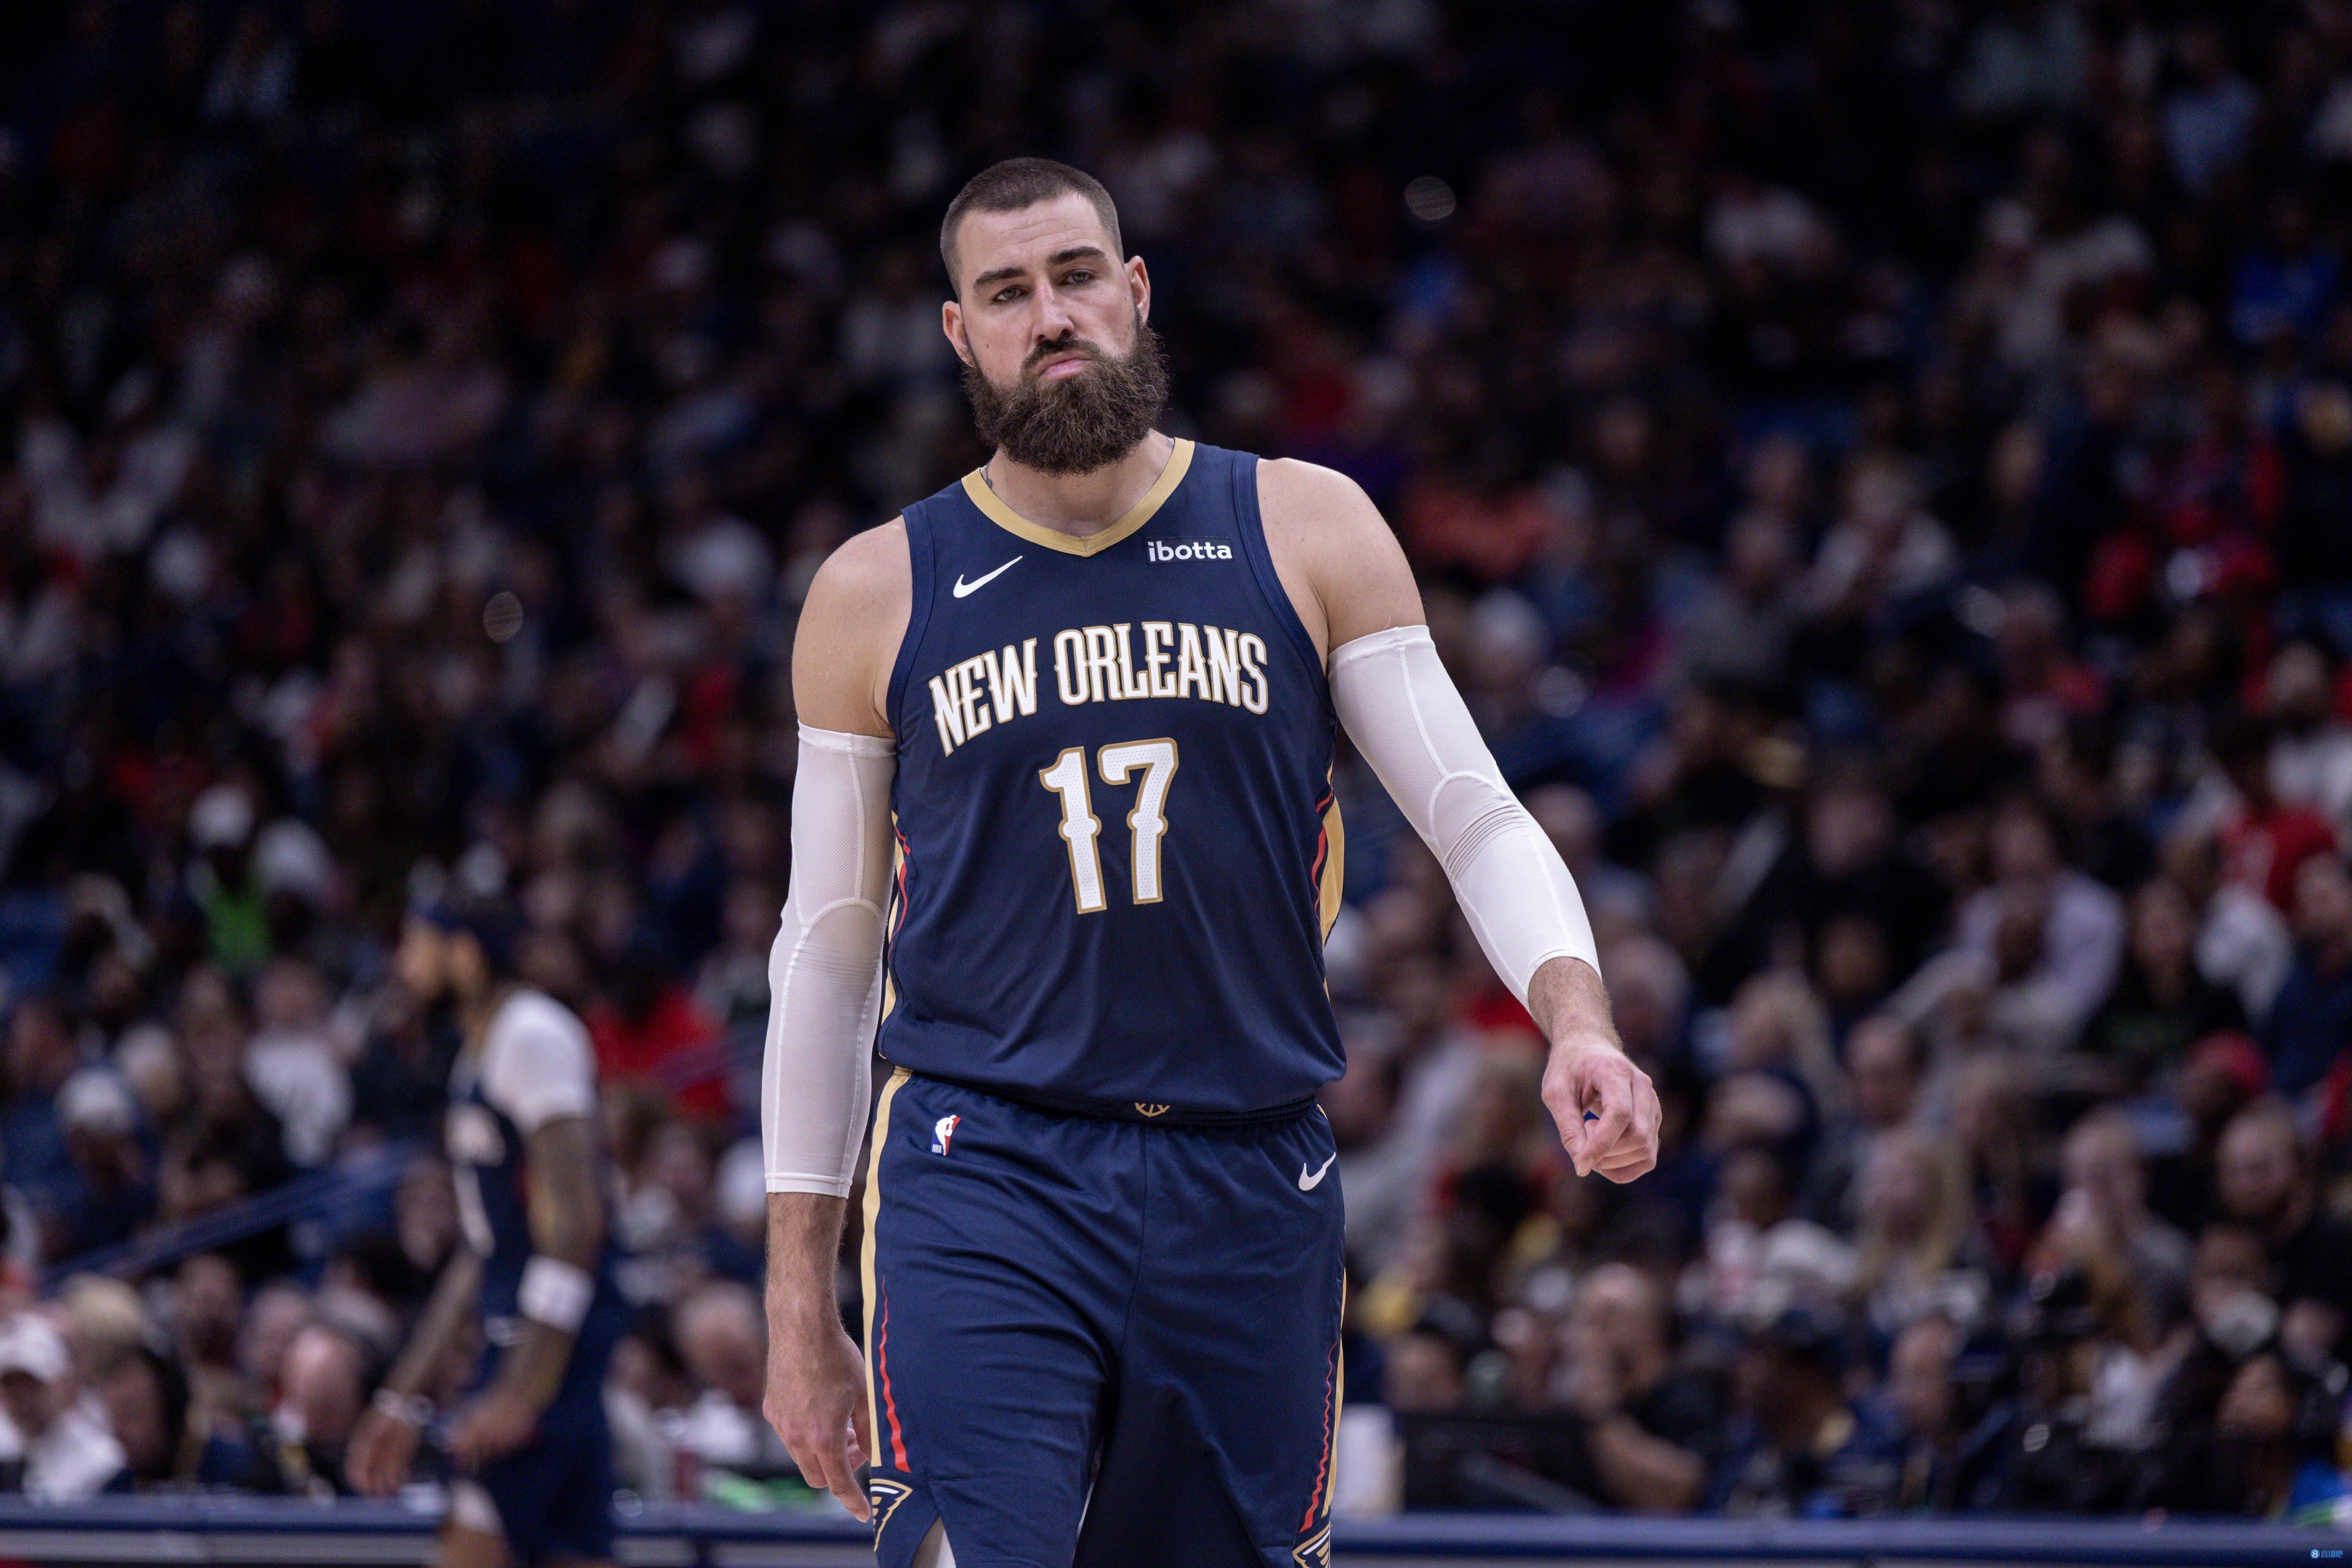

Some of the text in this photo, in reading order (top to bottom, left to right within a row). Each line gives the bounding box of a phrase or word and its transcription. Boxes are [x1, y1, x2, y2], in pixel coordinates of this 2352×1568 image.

[1148, 541, 1233, 561] ibotta
[929, 621, 1269, 757] NEW ORLEANS
[1039, 737, 1179, 914] 17
[932, 1144, 942, 1153] NBA
